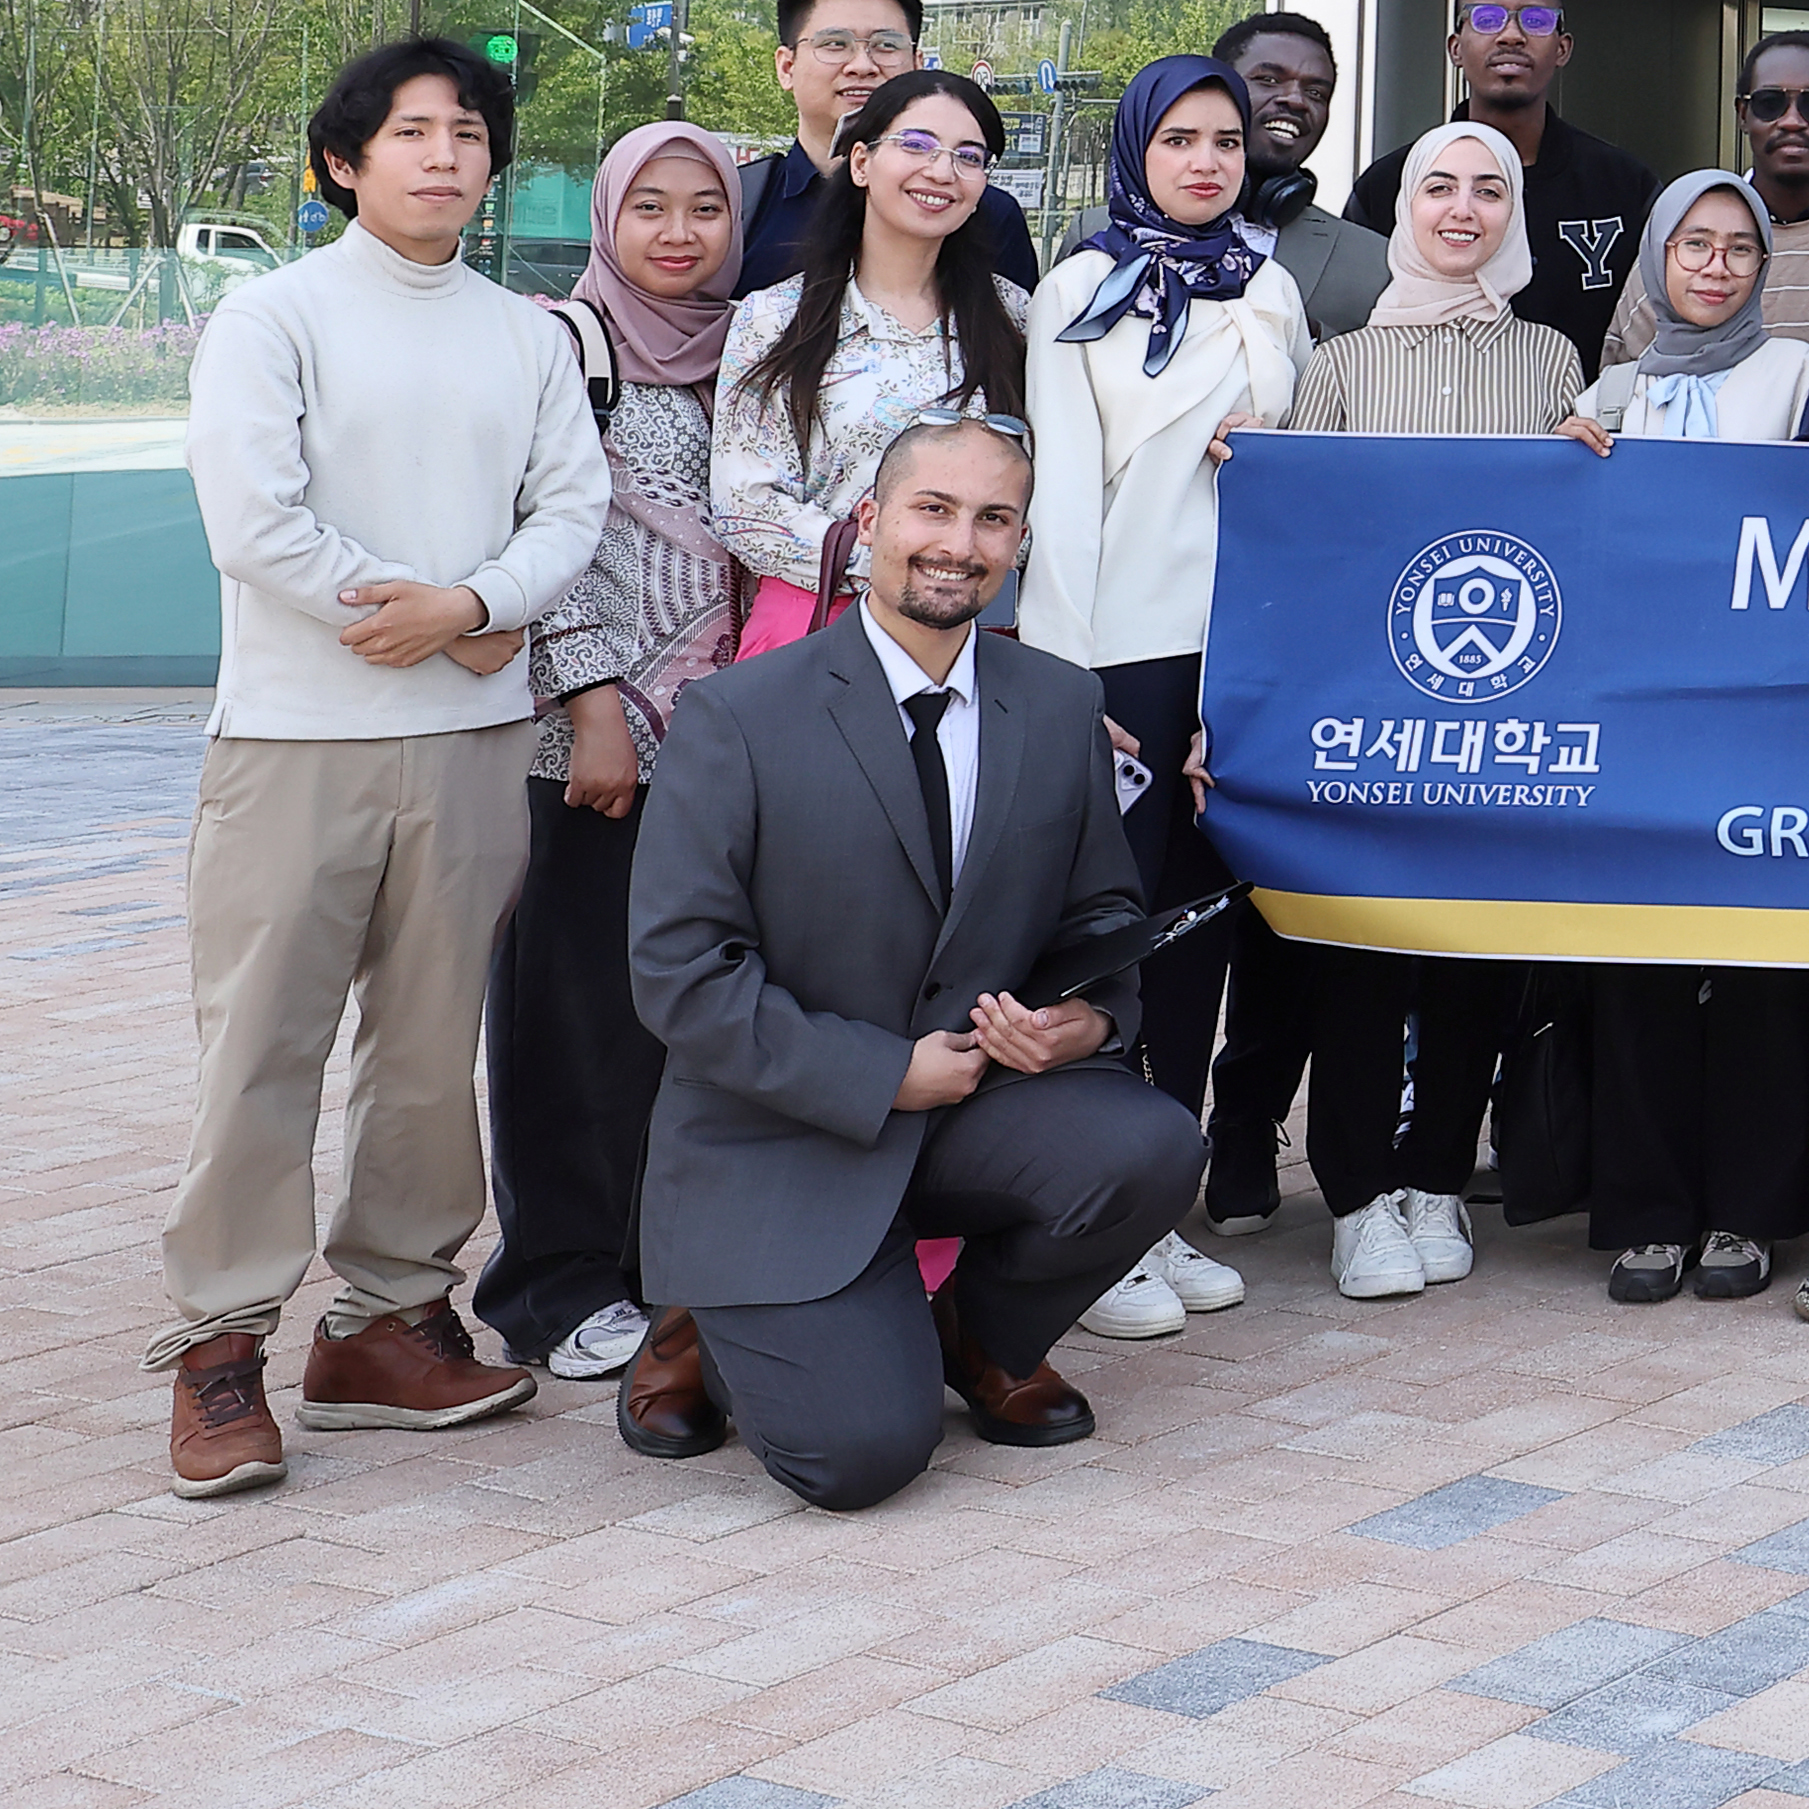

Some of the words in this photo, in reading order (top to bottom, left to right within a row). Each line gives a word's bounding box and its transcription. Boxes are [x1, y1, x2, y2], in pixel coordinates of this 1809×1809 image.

[1557, 216, 1625, 291] Y
[1395, 546, 1452, 617] YONSEI
[1458, 537, 1555, 617] UNIVERSITY
[1404, 653, 1537, 697] 연세대학교
[1458, 654, 1482, 666] 1885
[1311, 717, 1600, 775] 연세대학교
[1306, 780, 1415, 805] YONSEI
[1423, 782, 1596, 808] UNIVERSITY
